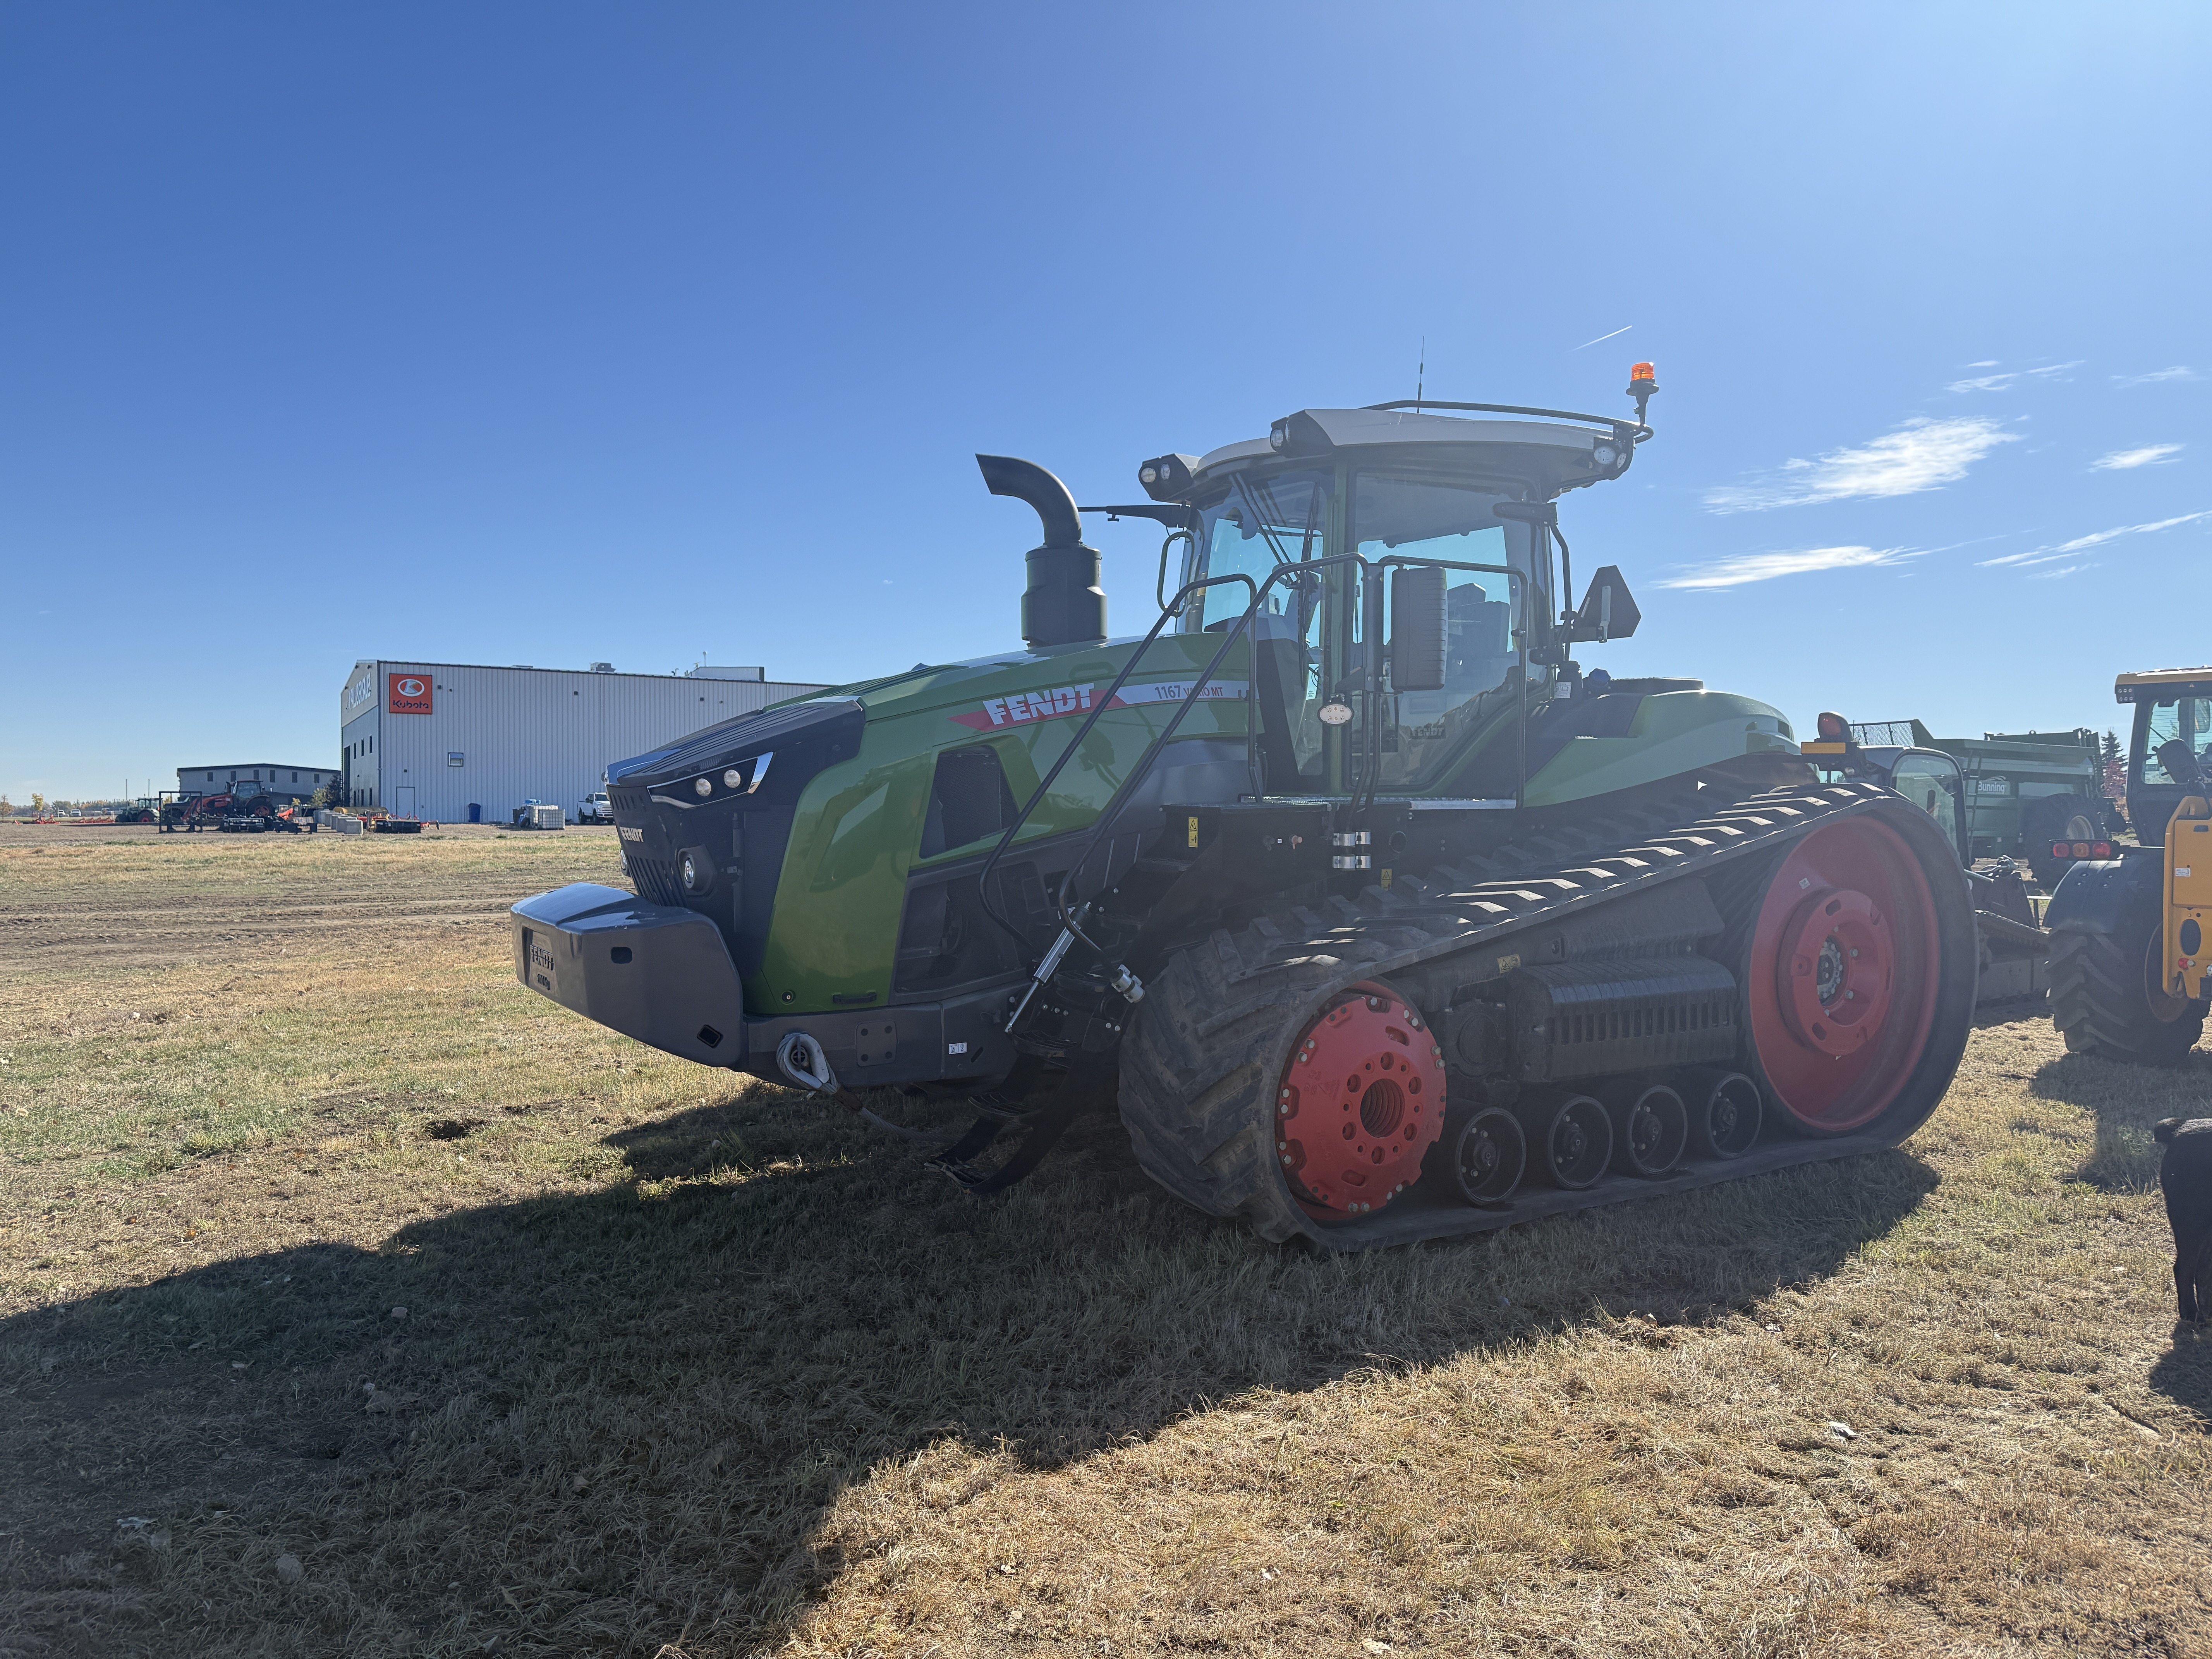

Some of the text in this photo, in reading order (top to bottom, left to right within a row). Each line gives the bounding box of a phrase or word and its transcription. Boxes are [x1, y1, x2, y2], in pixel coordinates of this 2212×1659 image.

[1155, 685, 1180, 699] 1167
[1211, 687, 1223, 696] MT
[393, 700, 429, 708] Kubota
[982, 683, 1094, 725] FENDT
[1978, 781, 2004, 794] Bunning
[620, 826, 644, 842] FENDT
[530, 945, 554, 971] FENDT
